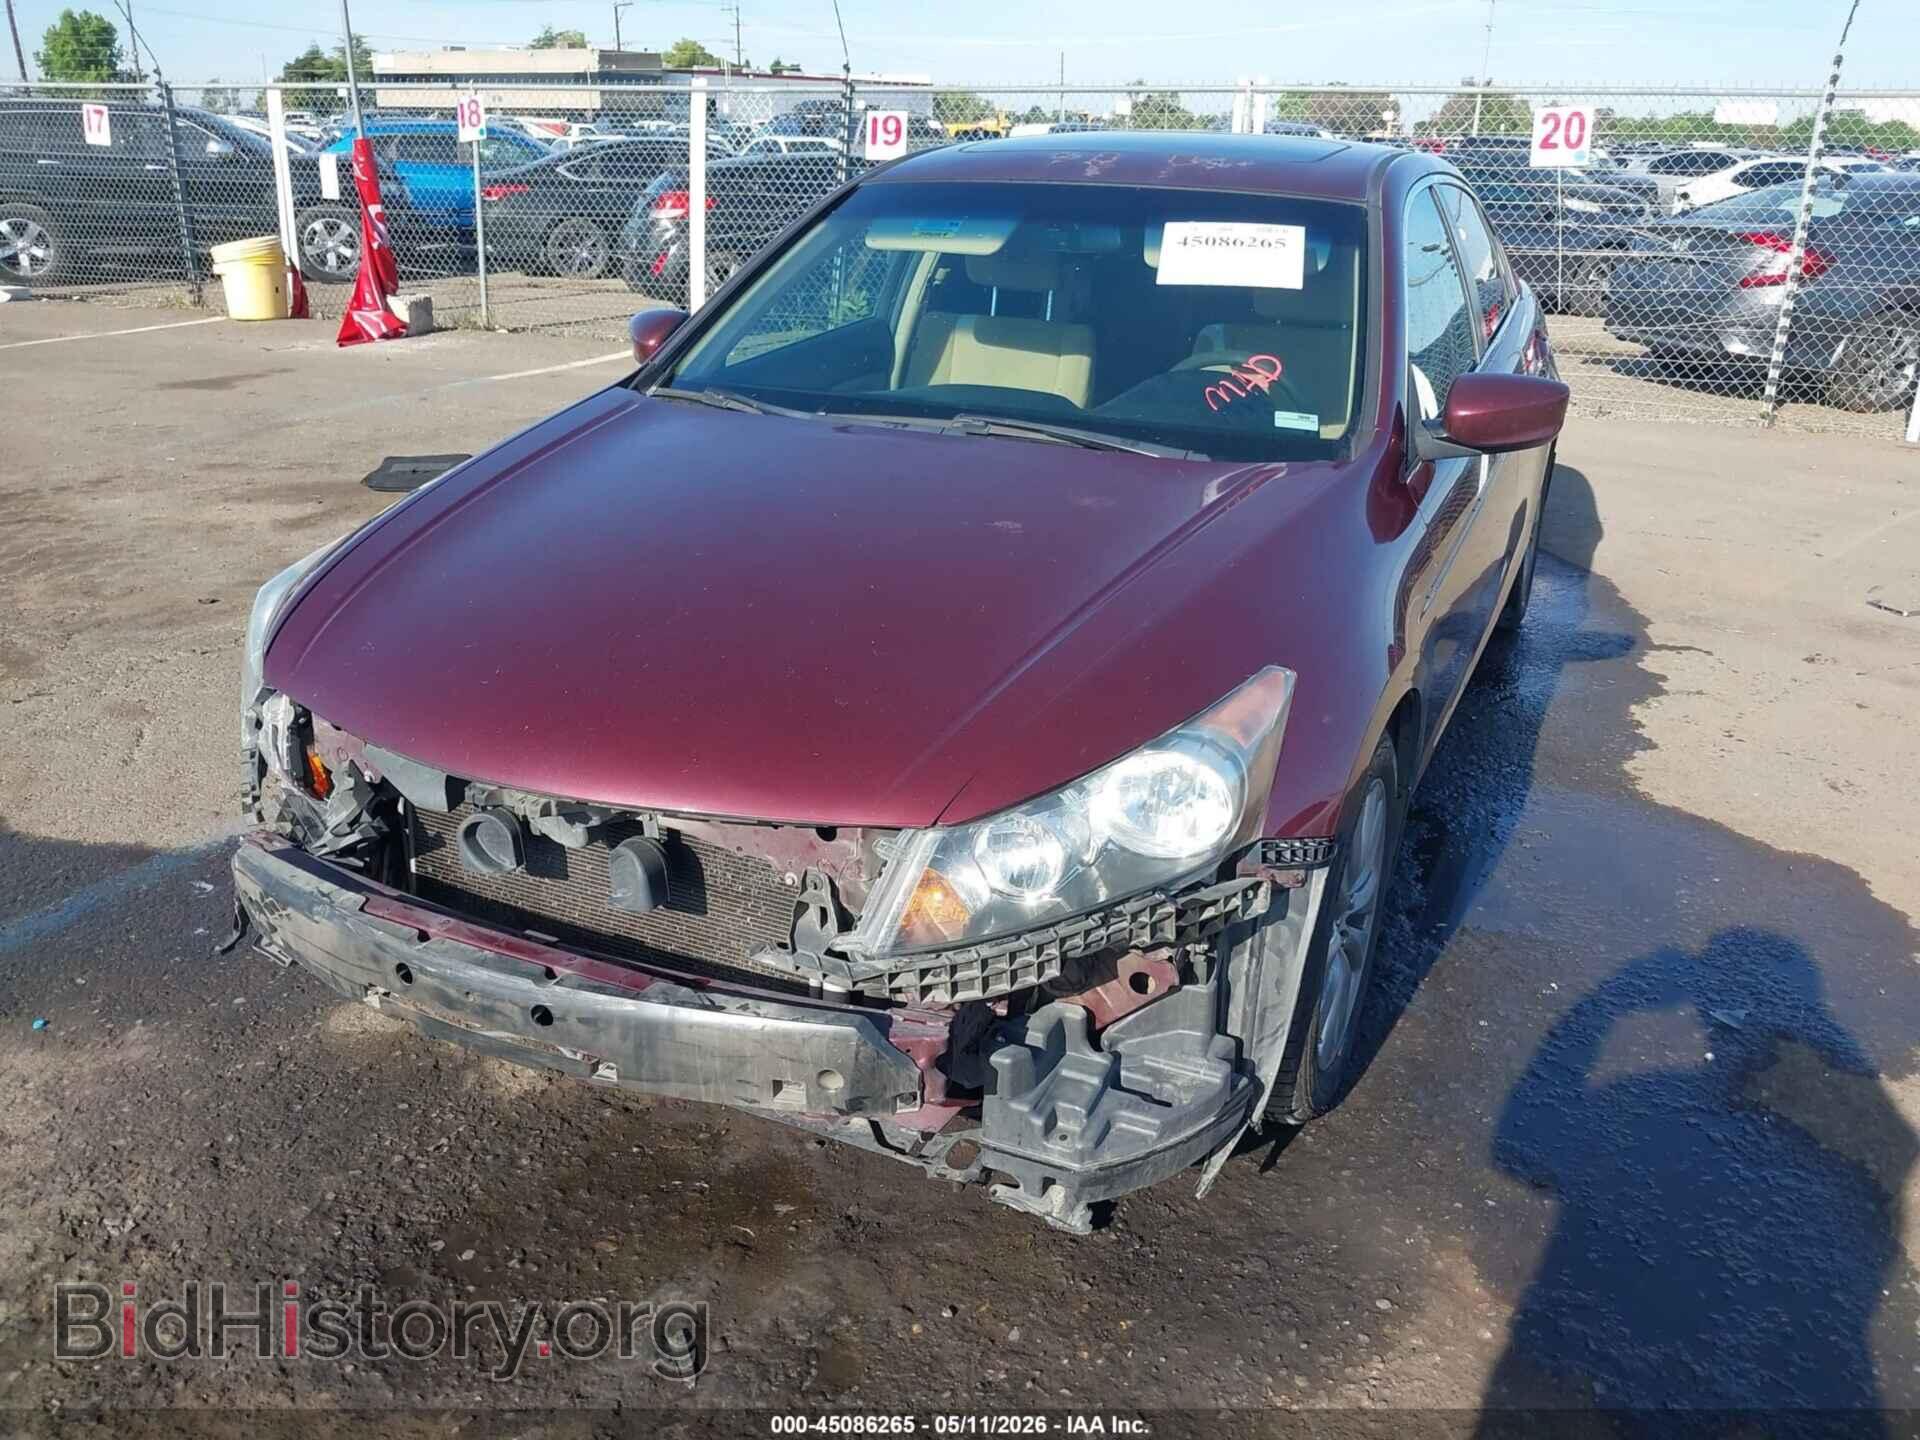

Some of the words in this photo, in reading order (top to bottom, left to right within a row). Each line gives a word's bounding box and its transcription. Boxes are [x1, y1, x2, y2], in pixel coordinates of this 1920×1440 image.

[86, 109, 104, 133] 17
[460, 99, 481, 128] 18
[871, 115, 902, 146] 19
[1539, 111, 1586, 149] 20
